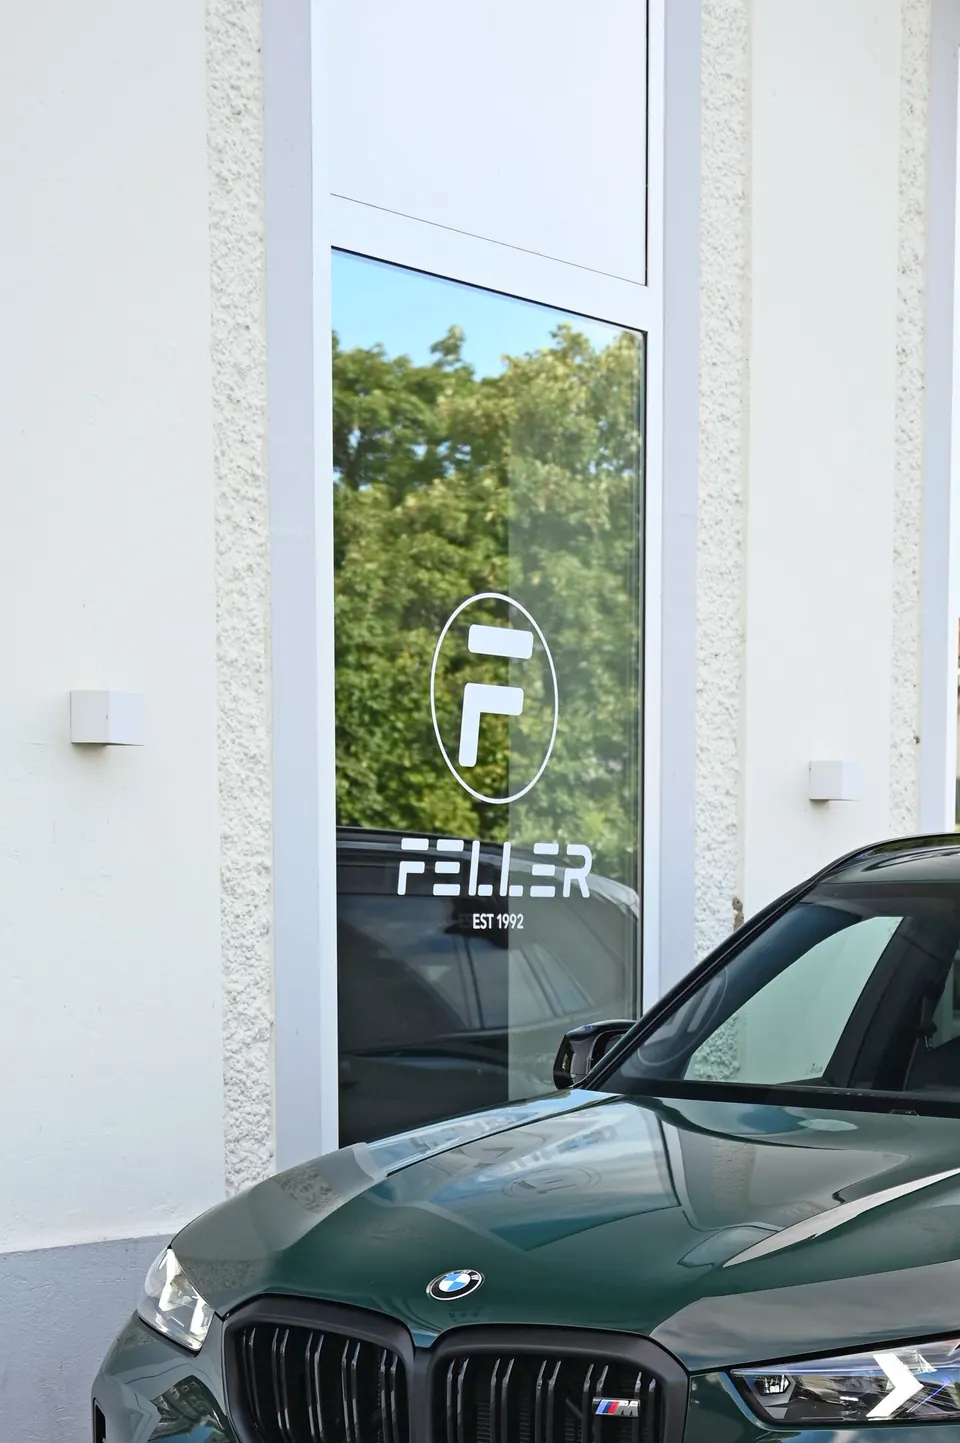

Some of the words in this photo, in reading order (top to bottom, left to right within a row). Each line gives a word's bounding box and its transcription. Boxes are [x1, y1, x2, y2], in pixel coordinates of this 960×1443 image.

[458, 624, 534, 767] F
[397, 838, 592, 898] FELLER
[472, 914, 494, 929] EST
[496, 914, 524, 929] 1992
